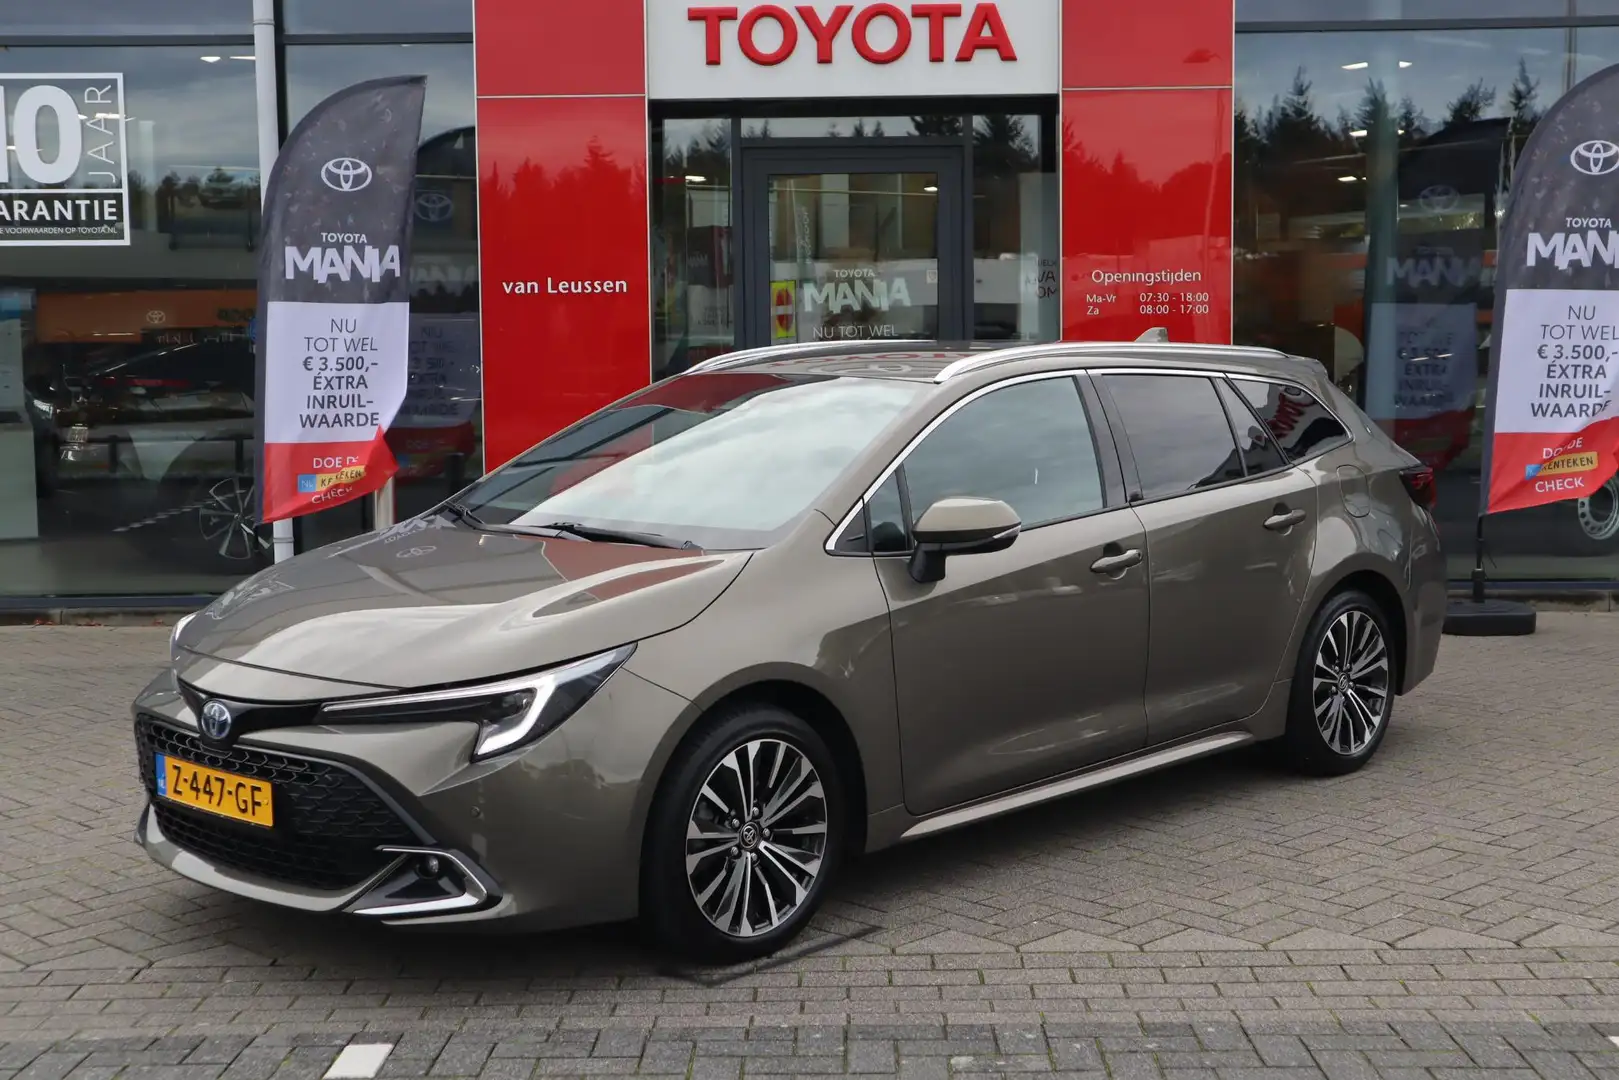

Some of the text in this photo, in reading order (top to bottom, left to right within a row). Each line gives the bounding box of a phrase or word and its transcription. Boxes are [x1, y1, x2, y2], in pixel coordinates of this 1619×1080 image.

[688, 3, 1017, 66] TOYOTA
[84, 84, 116, 184] JAAR
[6, 226, 64, 234] VOORWAARDEN
[65, 226, 77, 234] OP
[1566, 217, 1612, 228] TOYOTA
[320, 232, 368, 244] TOYOTA
[284, 244, 401, 284] MANIA
[833, 268, 876, 278] TOYOTA
[1091, 269, 1202, 286] Openingstijden
[502, 277, 627, 294] van Leussen
[802, 277, 912, 314] MANIA
[1086, 294, 1117, 303] Ma-Vr
[1140, 292, 1170, 302] 07:30
[1180, 292, 1209, 302] 18:00
[1086, 305, 1100, 315] Za
[1140, 304, 1170, 314] 08:00
[1180, 304, 1209, 314] 17:00
[1567, 305, 1596, 320] NU
[330, 318, 357, 334] NU
[813, 324, 899, 339] NU TOT WEL
[1540, 324, 1576, 340] TOT
[304, 336, 378, 352] TOT WEL
[1537, 344, 1618, 363] € 3.500,-
[302, 356, 379, 373] € 3.500,-
[1546, 360, 1607, 380] ÉXTRA
[312, 371, 368, 391] ÉXTRA
[1539, 382, 1611, 399] INRUIL-
[307, 393, 374, 409] INRUIL-
[299, 412, 380, 429] WAARDE
[313, 456, 343, 469] DOE
[1535, 476, 1585, 493] CHECK
[172, 764, 263, 817] Z-447-GF
